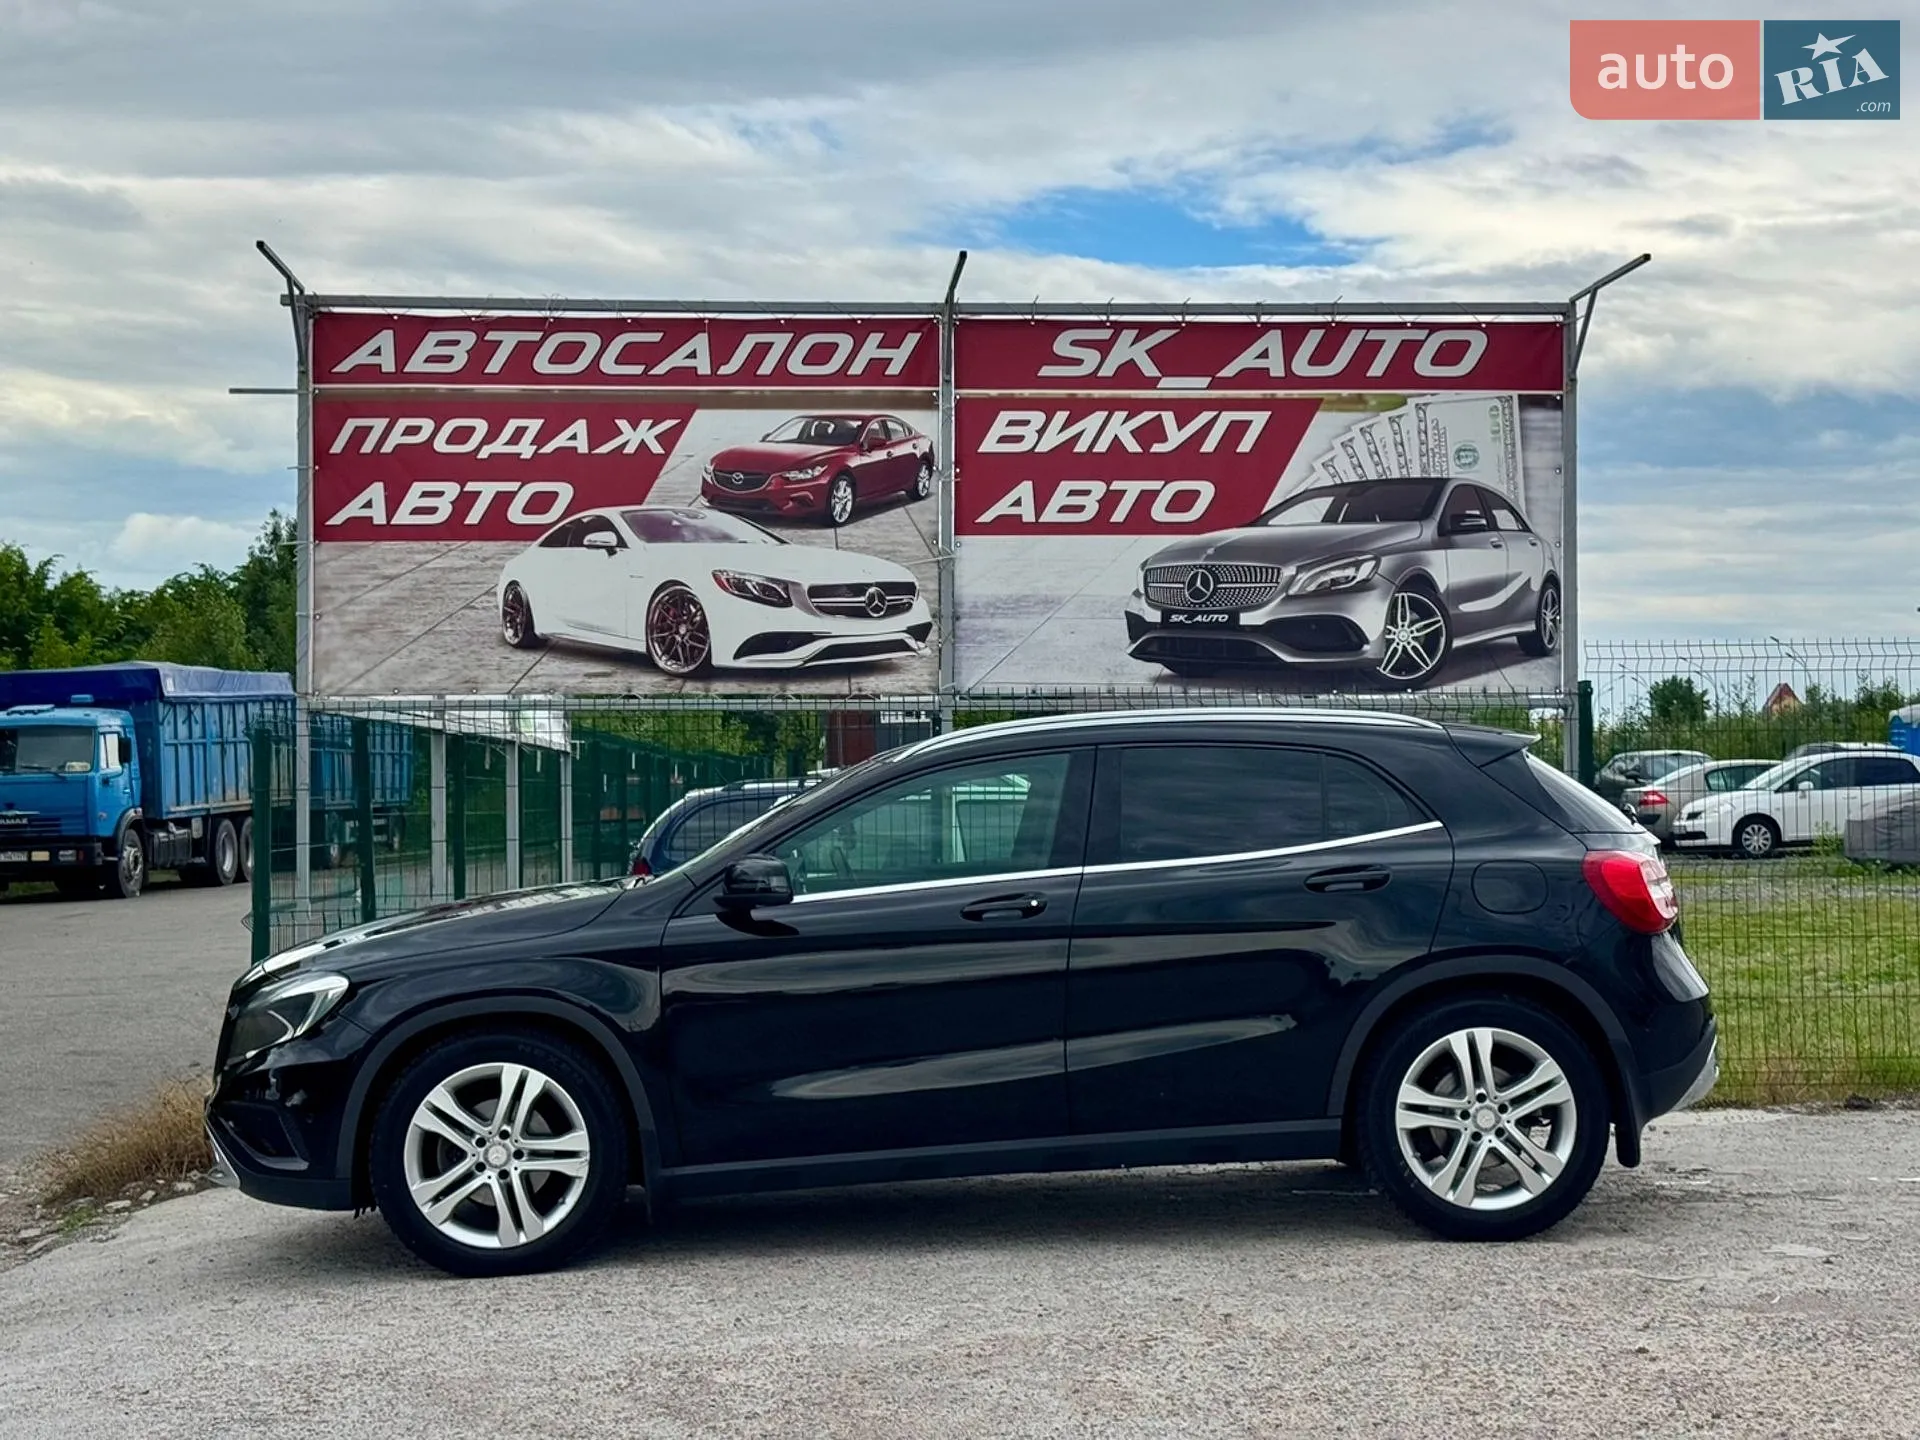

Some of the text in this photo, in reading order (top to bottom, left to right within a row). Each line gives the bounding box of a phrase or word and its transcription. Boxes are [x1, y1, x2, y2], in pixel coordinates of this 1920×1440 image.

[331, 329, 922, 375] АВТОСАЛОН
[1037, 329, 1488, 389] SK_AUTO
[329, 417, 681, 460] ПРОДАЖ
[977, 410, 1272, 453] ВИКУП
[325, 481, 574, 525] АВТО
[974, 480, 1216, 523] АВТО
[1169, 614, 1229, 624] SK_AUTO
